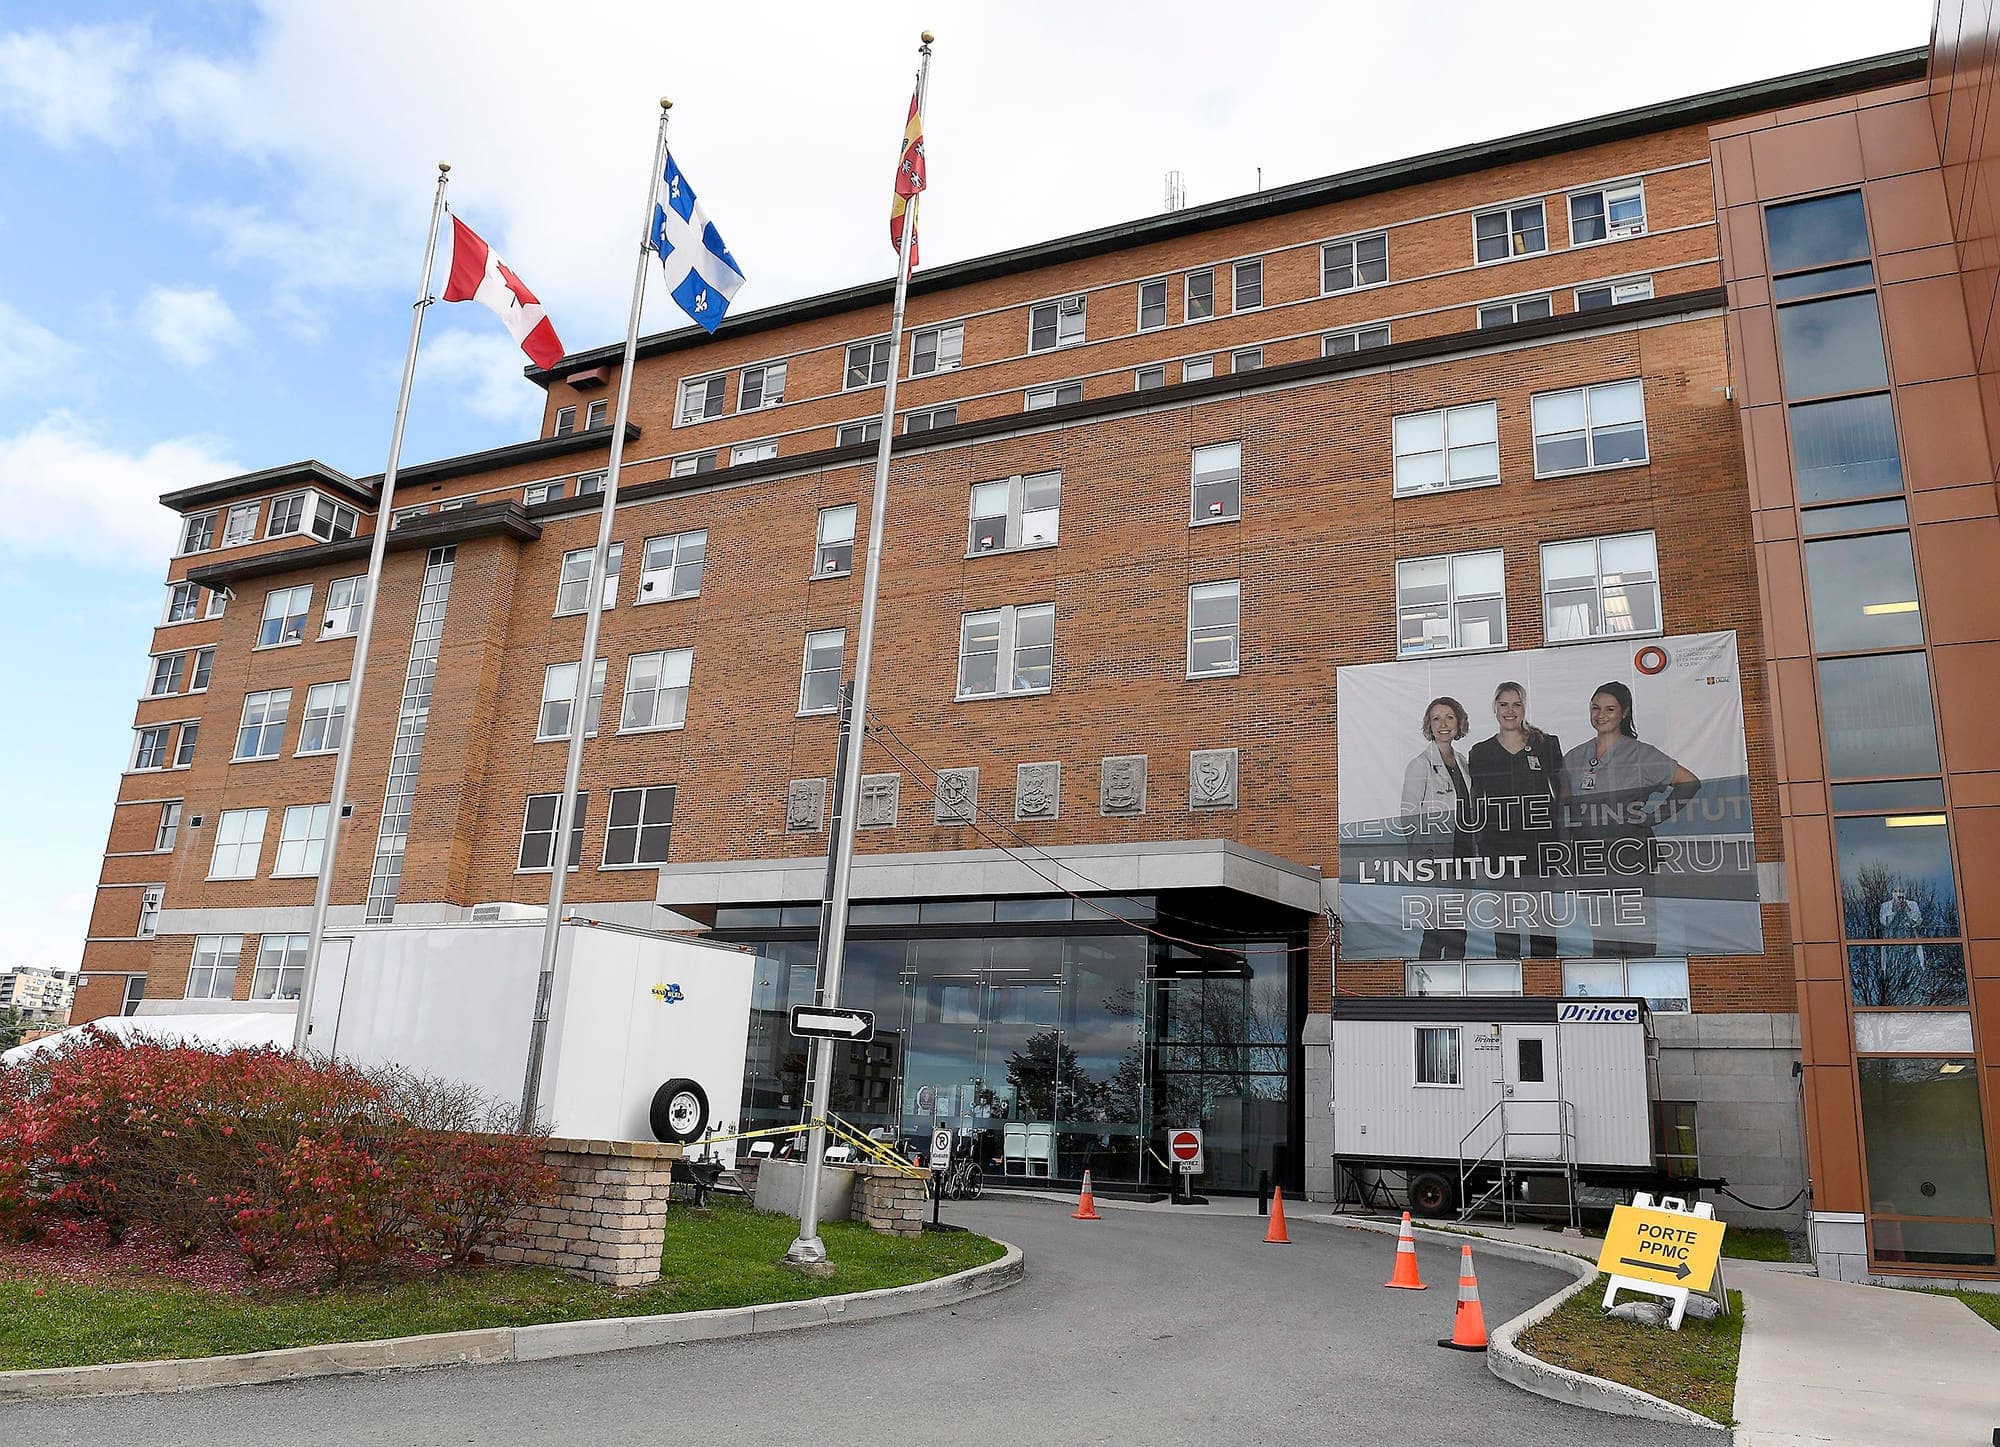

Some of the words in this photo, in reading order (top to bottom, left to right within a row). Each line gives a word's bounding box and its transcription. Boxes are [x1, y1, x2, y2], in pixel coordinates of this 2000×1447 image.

[1564, 796, 1743, 828] L'INSTITUT
[1359, 855, 1526, 884] L'INSTITUT
[1538, 834, 1754, 878] RECRUT
[1402, 888, 1645, 931] RECRUTE
[1560, 1004, 1638, 1021] Prince
[1637, 1223, 1697, 1245] PORTE
[1639, 1240, 1690, 1260] PPMC
